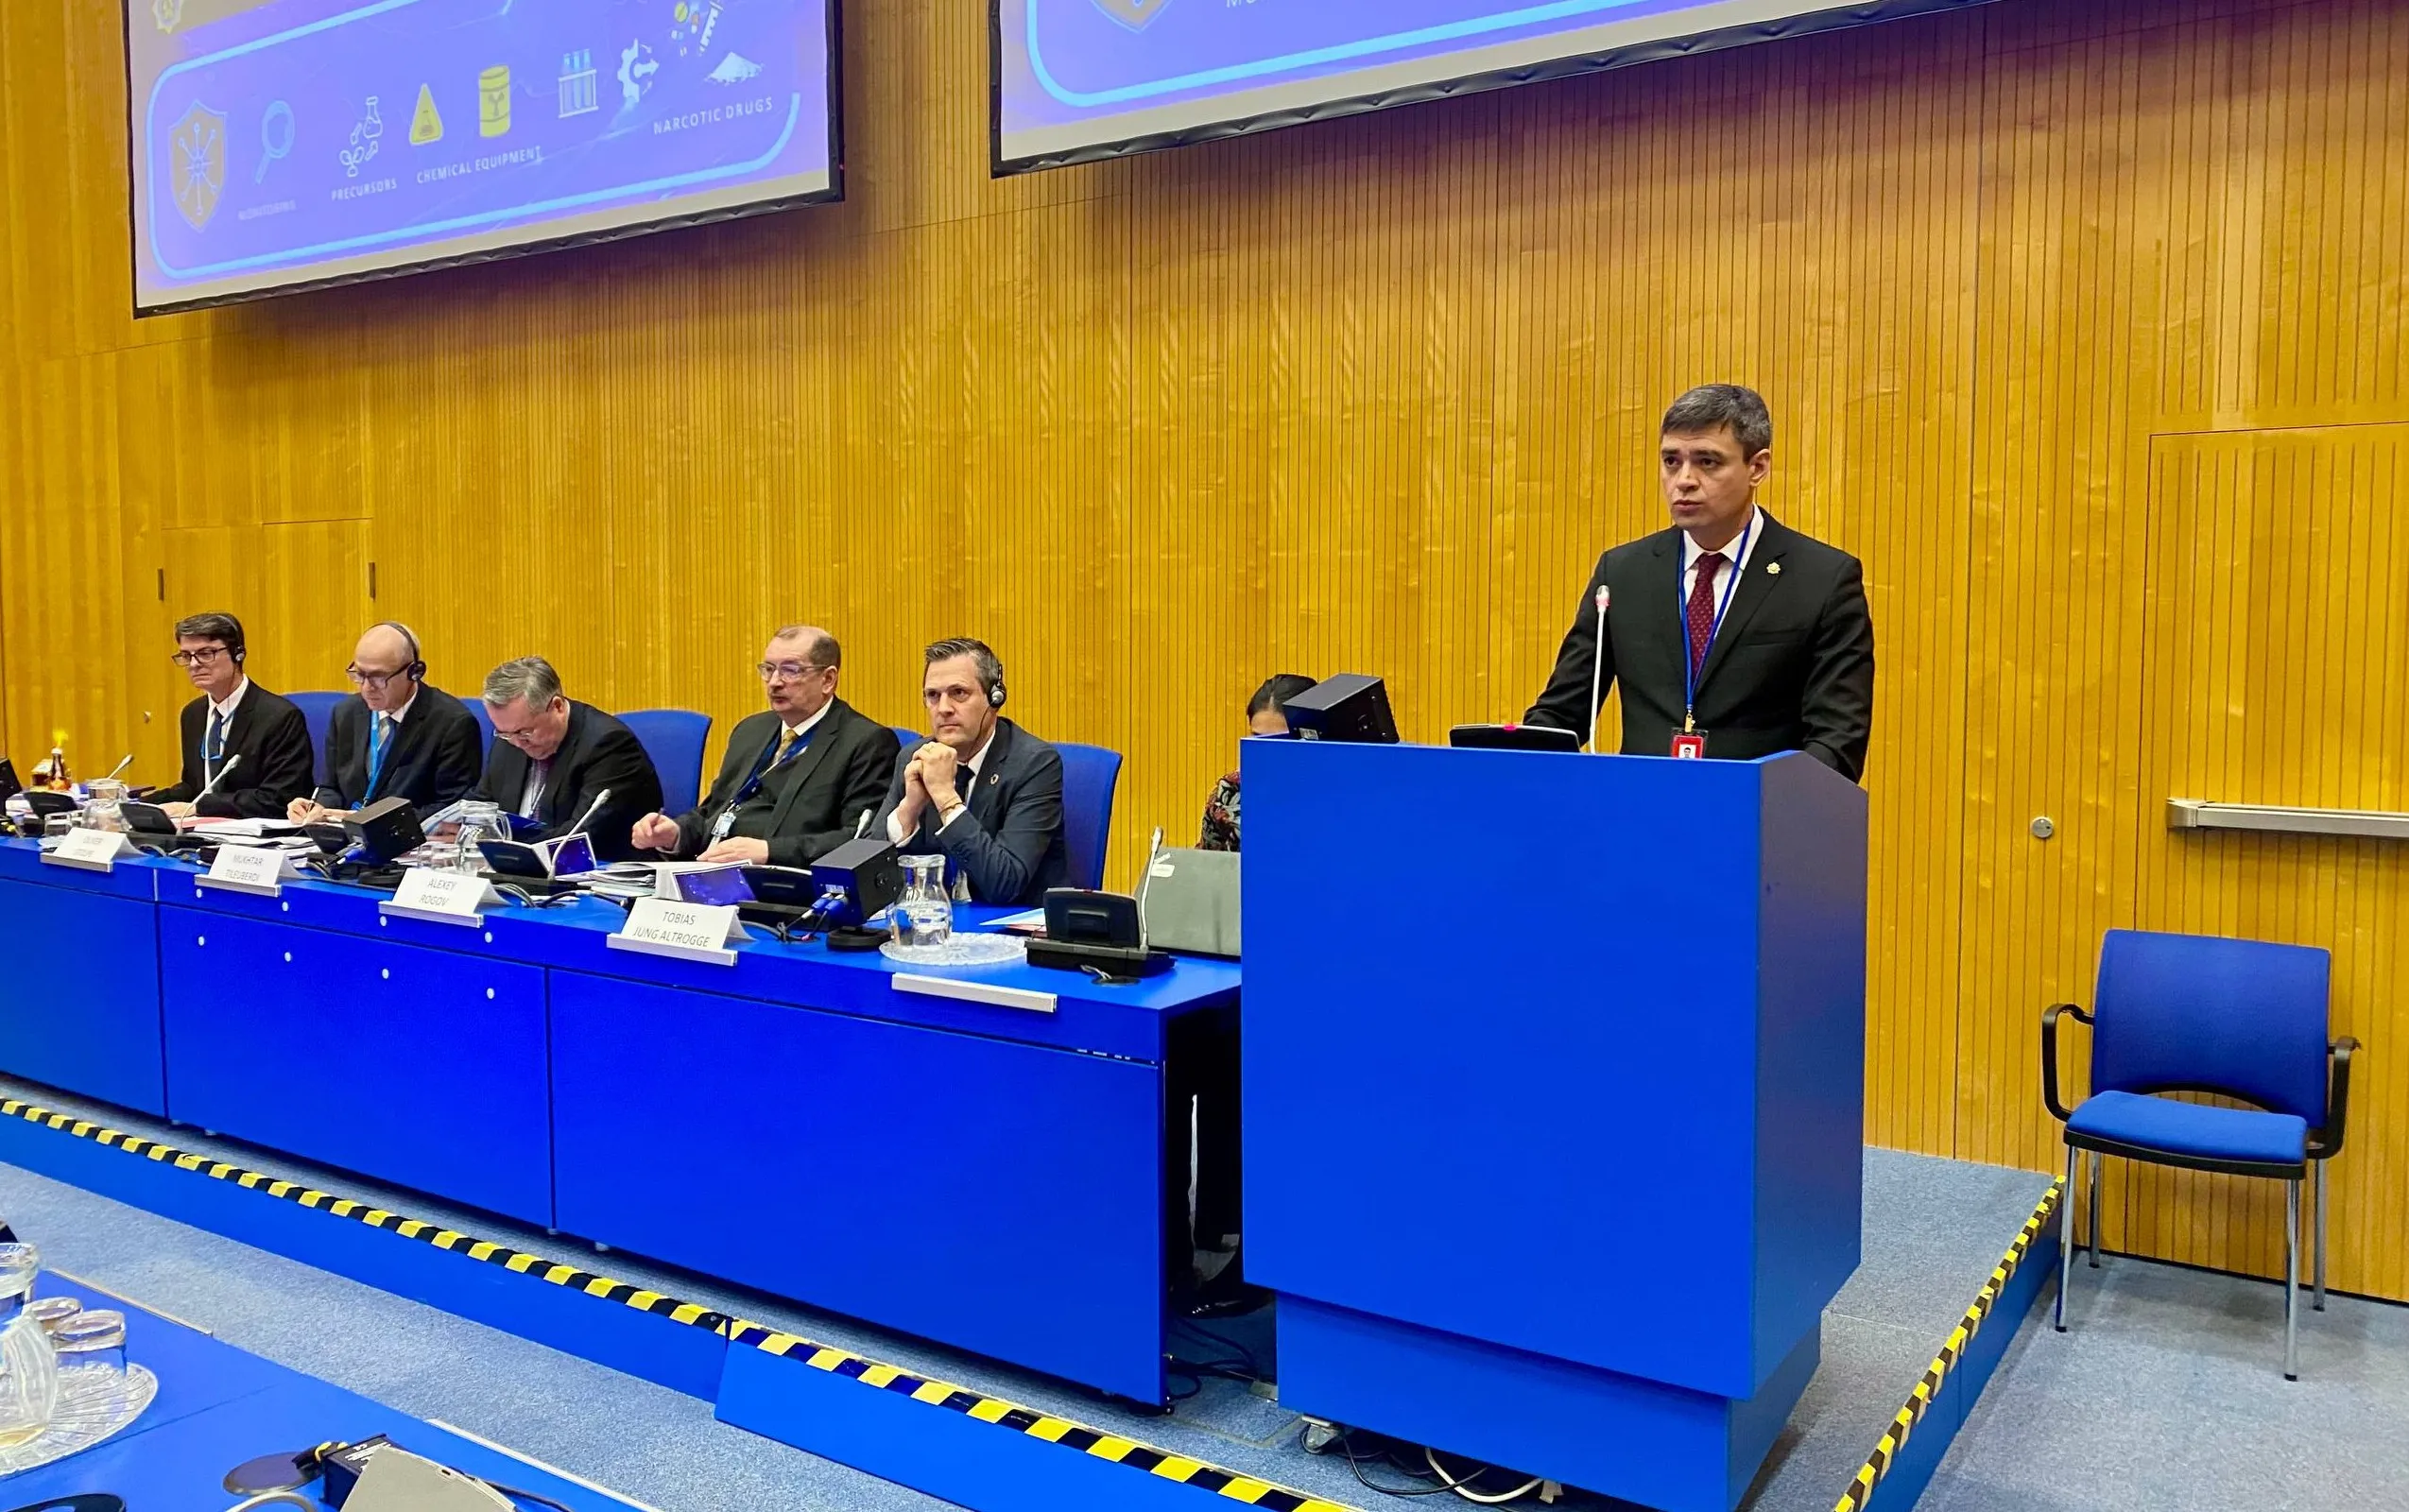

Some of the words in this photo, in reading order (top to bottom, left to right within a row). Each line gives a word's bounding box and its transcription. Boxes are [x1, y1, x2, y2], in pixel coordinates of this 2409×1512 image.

[653, 108, 721, 134] NARCOTIC
[725, 96, 772, 119] DRUGS
[417, 162, 472, 183] CHEMICAL
[475, 146, 542, 171] EQUIPMENT
[332, 179, 397, 201] PRECURSORS
[427, 878, 457, 890] ALEXEY
[419, 894, 449, 906] ROGOV
[662, 912, 696, 925] TOBIAS
[633, 927, 659, 939] JUNG
[661, 930, 711, 947] ALTROGGE
